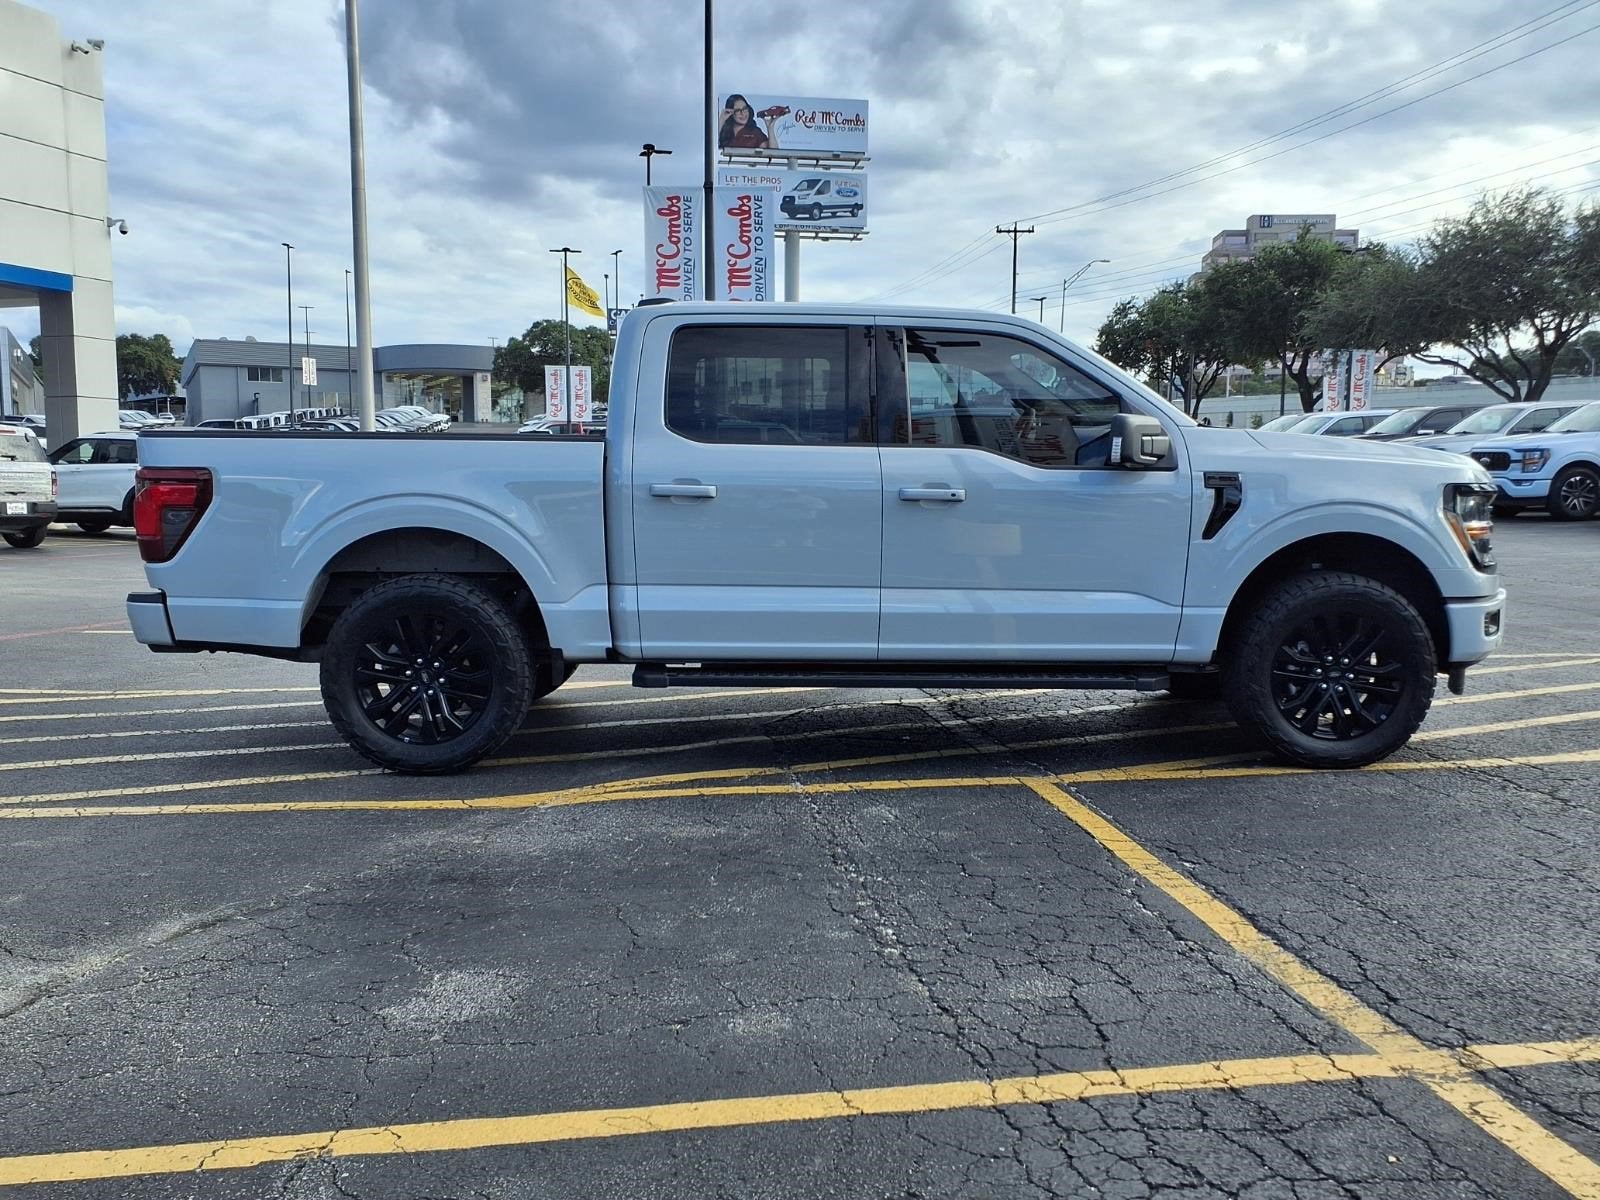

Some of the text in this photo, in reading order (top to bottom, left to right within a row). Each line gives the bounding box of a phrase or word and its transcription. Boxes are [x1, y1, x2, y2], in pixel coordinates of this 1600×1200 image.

[795, 108, 866, 129] Red McCombs
[814, 125, 837, 133] DRIVEN
[725, 175, 782, 185] LET THE PROS
[655, 194, 682, 294] McCombs
[683, 195, 695, 301] DRIVEN TO SERVE
[727, 194, 752, 295] McCombs
[753, 194, 766, 301] DRIVEN TO SERVE
[550, 369, 563, 418] Red McCombs
[574, 369, 588, 419] Red McCombs
[1327, 396, 1340, 412] Red
[1351, 353, 1367, 411] Red McCombs
